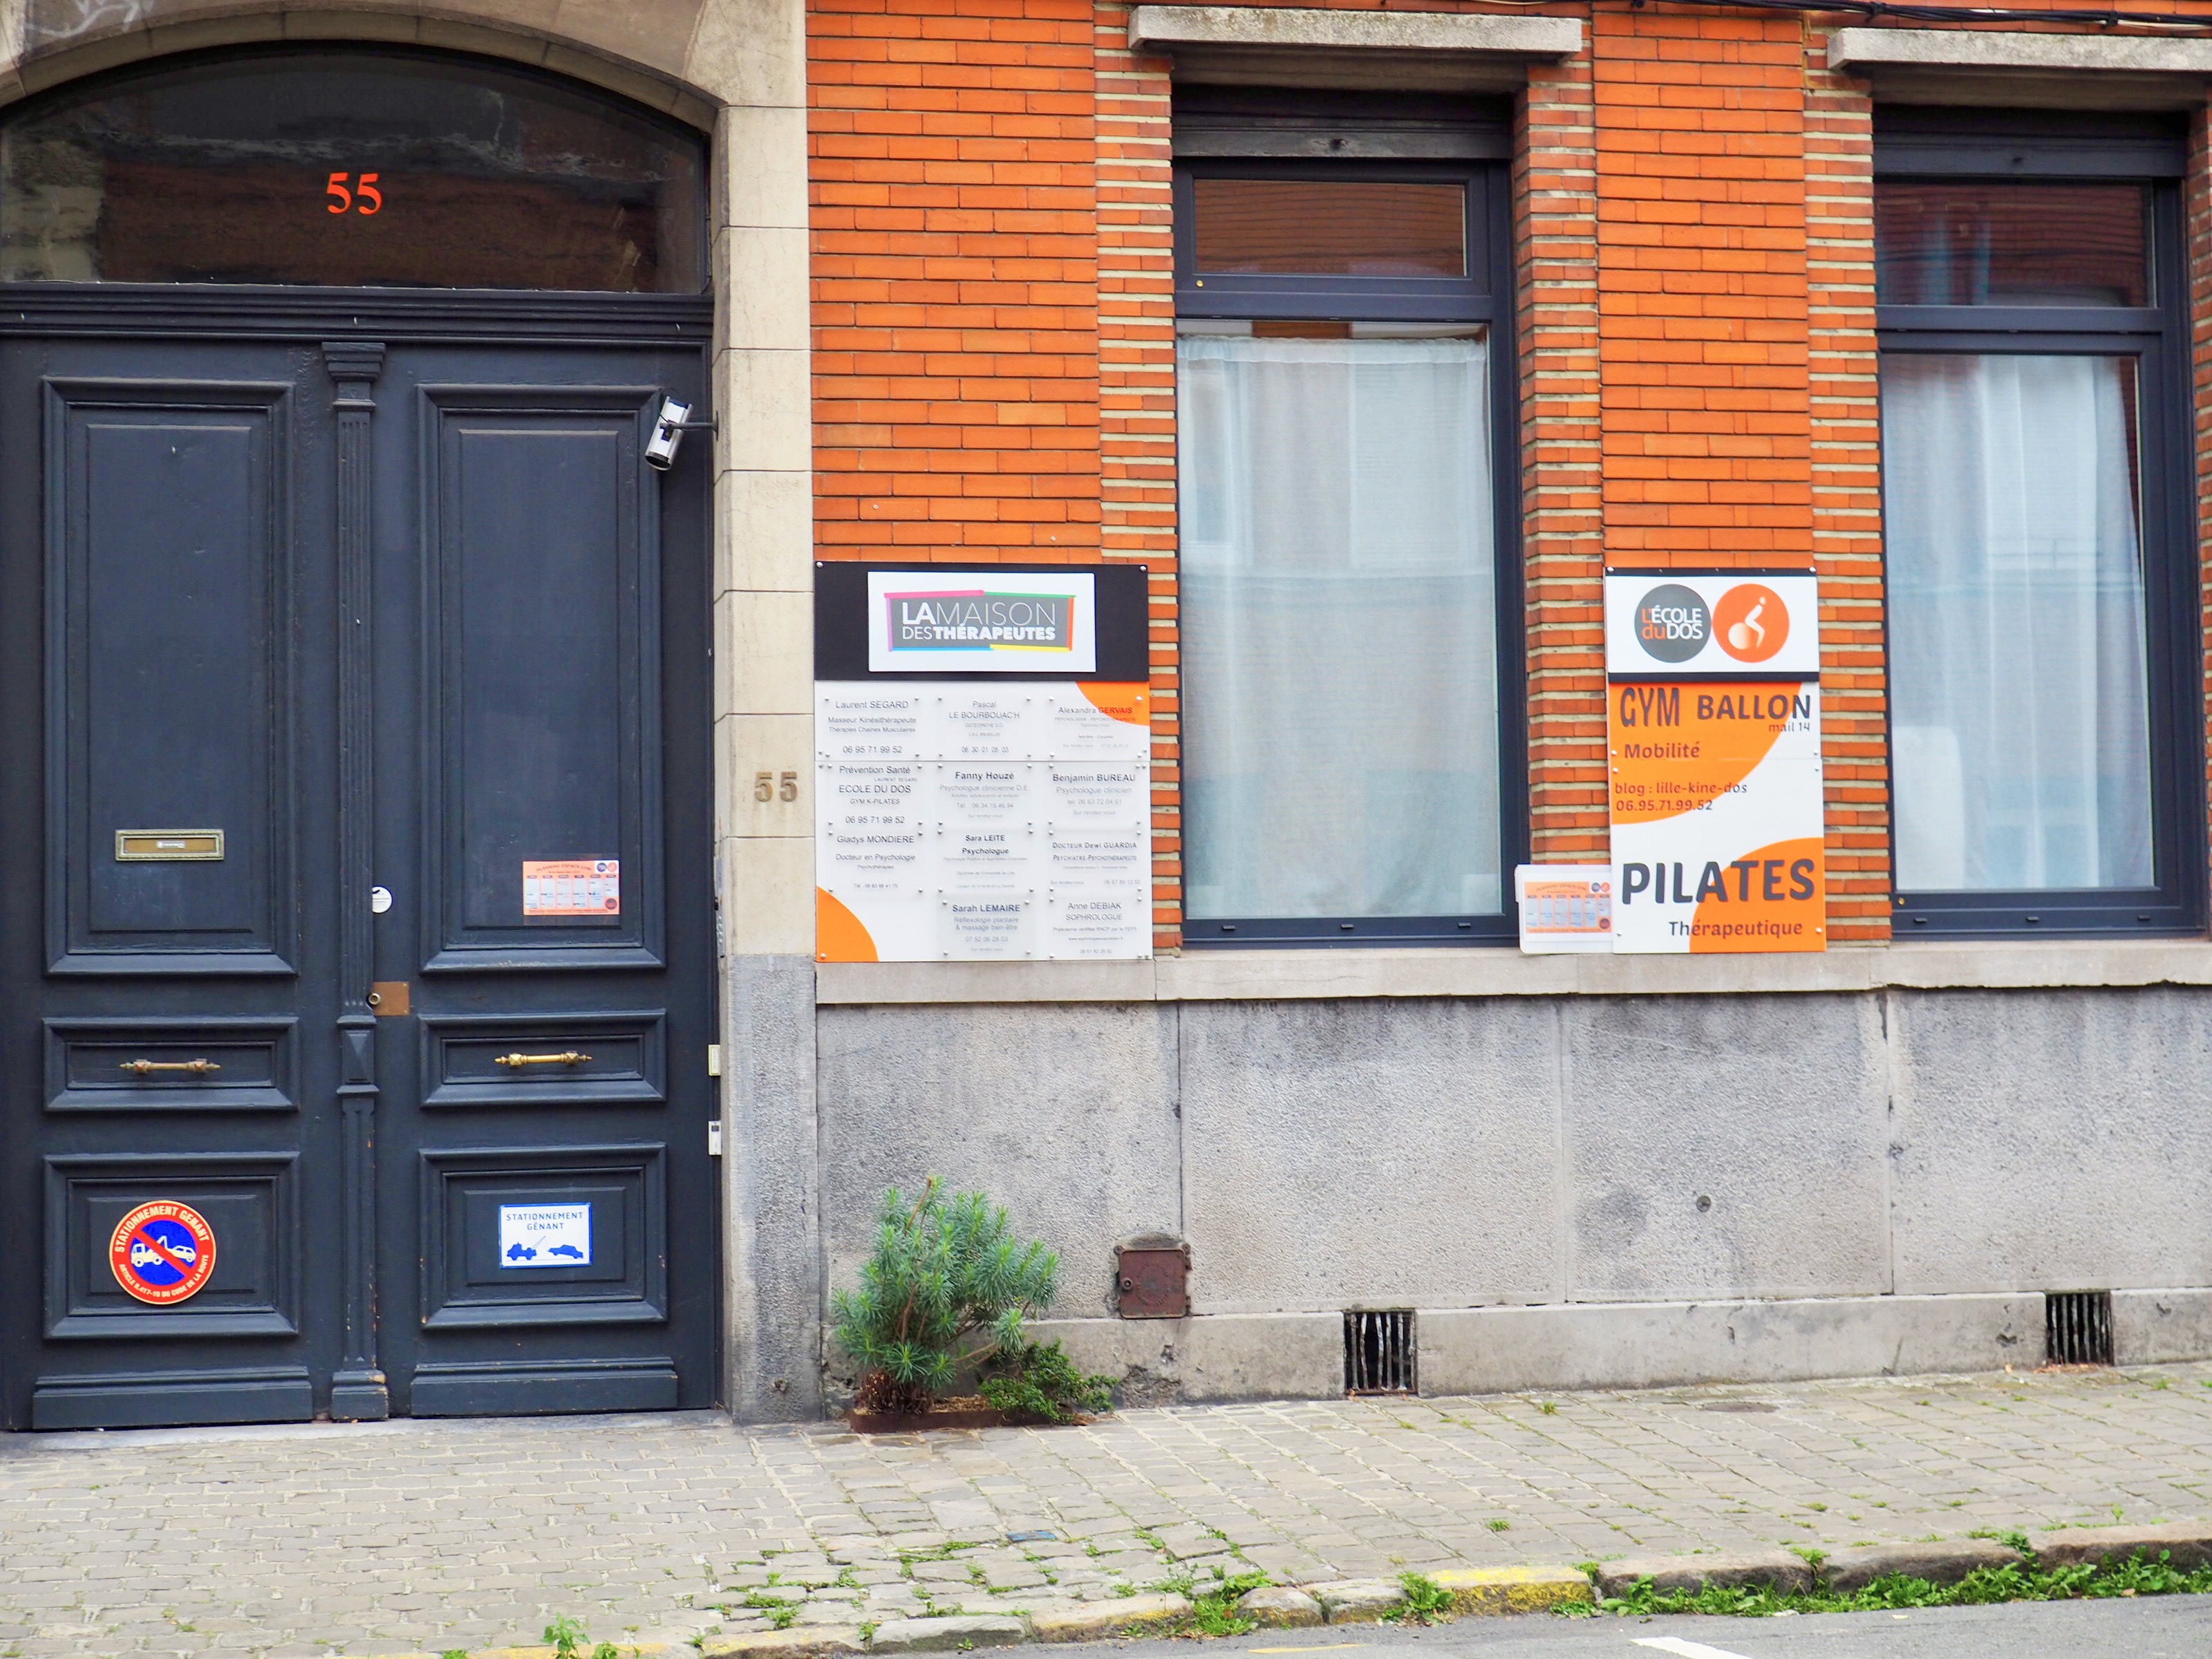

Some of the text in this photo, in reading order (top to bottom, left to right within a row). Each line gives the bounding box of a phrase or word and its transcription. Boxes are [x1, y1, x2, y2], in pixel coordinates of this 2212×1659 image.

[326, 172, 382, 216] 55
[1641, 605, 1702, 624] L'ÉCOLE
[835, 700, 909, 709] Laurent SEGARD
[1620, 687, 1810, 727] GYM BALLON
[1768, 722, 1810, 733] mail 14
[1624, 741, 1700, 758] Mobilité
[839, 765, 911, 774] Prévention Santé
[955, 771, 983, 781] Fanny
[1052, 774, 1136, 783] Benjamin BUREAU
[754, 771, 798, 803] 55
[838, 785, 912, 793] ECOLE DU DOS
[1056, 786, 1102, 795] Psychologue
[1615, 782, 1645, 796] blog
[1656, 782, 1747, 794] lille-kine-dos
[1616, 800, 1713, 811] 06.95.71.99.52
[845, 816, 905, 824] 06 95 71 99 52
[836, 835, 865, 845] Gladys
[962, 847, 1009, 856] Psychologue
[875, 853, 916, 862] Psychologie
[1622, 859, 1815, 905] PILATES
[953, 904, 1021, 912] Sarah LEMAIRE
[1669, 919, 1803, 939] Thérapeutique
[506, 1212, 583, 1221] STATIONNEMENT
[115, 1206, 210, 1253] STATIONNEMENT GENANT
[527, 1221, 564, 1230] GÊNANT
[119, 1264, 137, 1286] ARTICLE
[161, 1289, 171, 1297] DU
[171, 1284, 187, 1296] CODE
[187, 1279, 196, 1288] DE
[192, 1272, 202, 1282] LA
[198, 1255, 209, 1273] ROUTE
